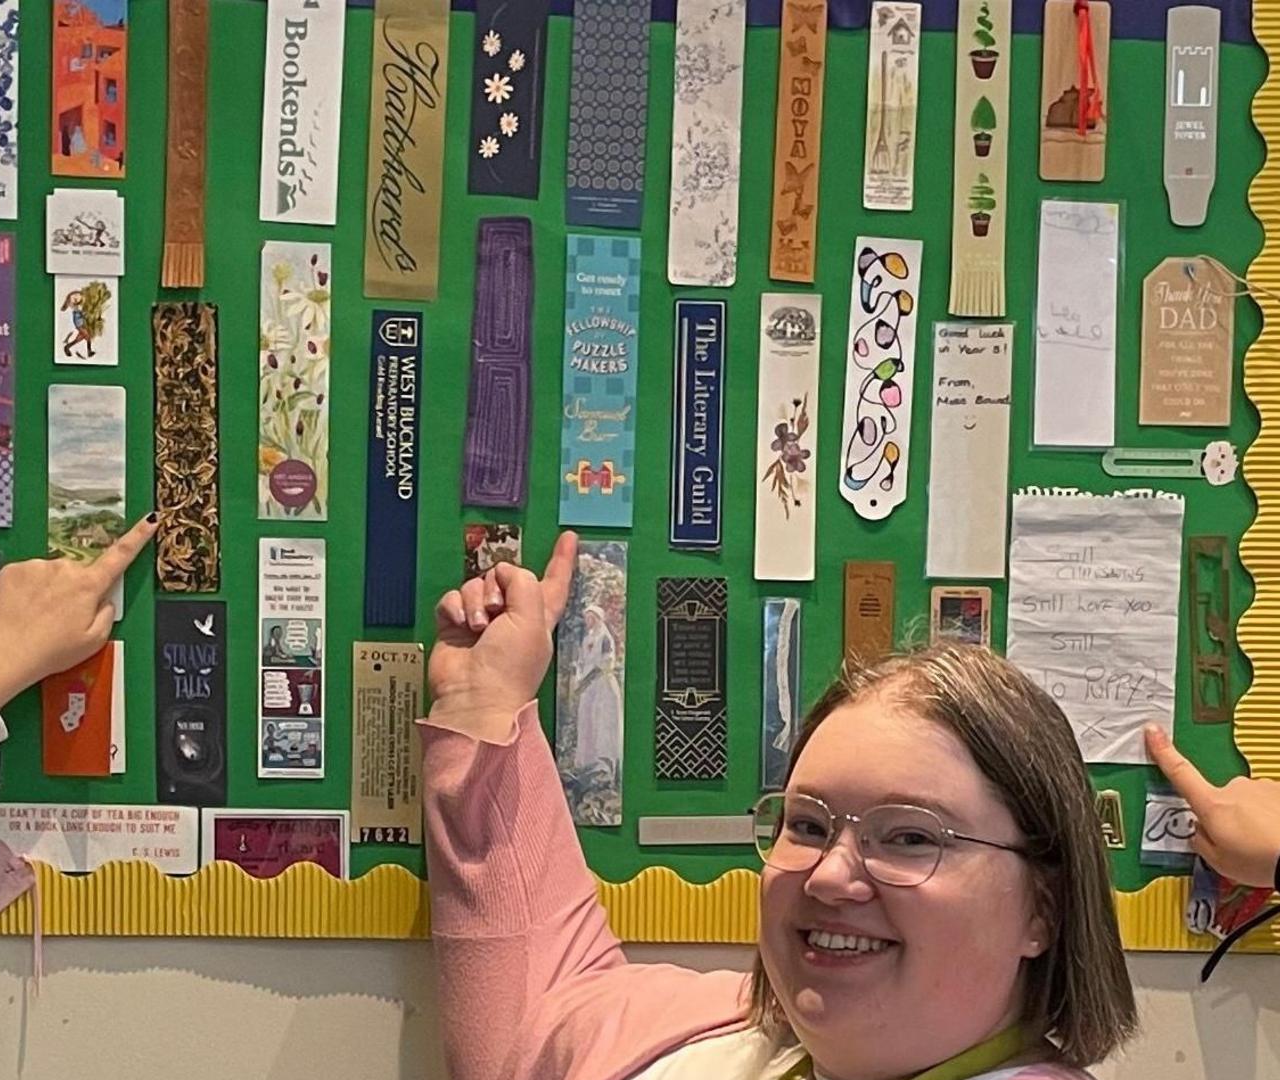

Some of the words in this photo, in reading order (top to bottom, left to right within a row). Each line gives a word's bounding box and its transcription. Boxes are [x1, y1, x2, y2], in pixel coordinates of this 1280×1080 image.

[277, 18, 308, 177] Bookends
[1175, 120, 1205, 131] JEWEL
[1174, 131, 1207, 141] TOWER
[576, 272, 594, 283] Get
[596, 273, 627, 286] ready
[581, 286, 593, 295] to
[595, 287, 622, 296] meet
[565, 315, 637, 338] FELLOWSHIP
[1159, 306, 1218, 330] DAD
[695, 318, 717, 363] The
[939, 328, 968, 339] Good
[979, 327, 1005, 339] luck
[572, 340, 628, 357] PUZZLE
[959, 344, 986, 355] Year
[569, 356, 629, 373] MAKERS
[400, 355, 416, 403] WEST
[387, 355, 399, 429] PREPARATORY
[686, 369, 717, 458] Literary
[385, 430, 397, 478] SCHOOL
[398, 405, 415, 500] BUCKLAND
[692, 465, 714, 527] Guild
[163, 643, 218, 669] STRANGE
[360, 651, 367, 661] 2
[174, 675, 211, 699] TALES
[107, 809, 124, 820] TEA
[144, 810, 180, 820] ENOUGH
[34, 822, 56, 832] BOOK
[61, 822, 84, 832] LONG
[87, 822, 122, 833] ENOUGH
[126, 823, 136, 833] TO
[140, 823, 159, 834] SUIT
[163, 823, 176, 834] ME
[154, 848, 180, 858] LEWIS
